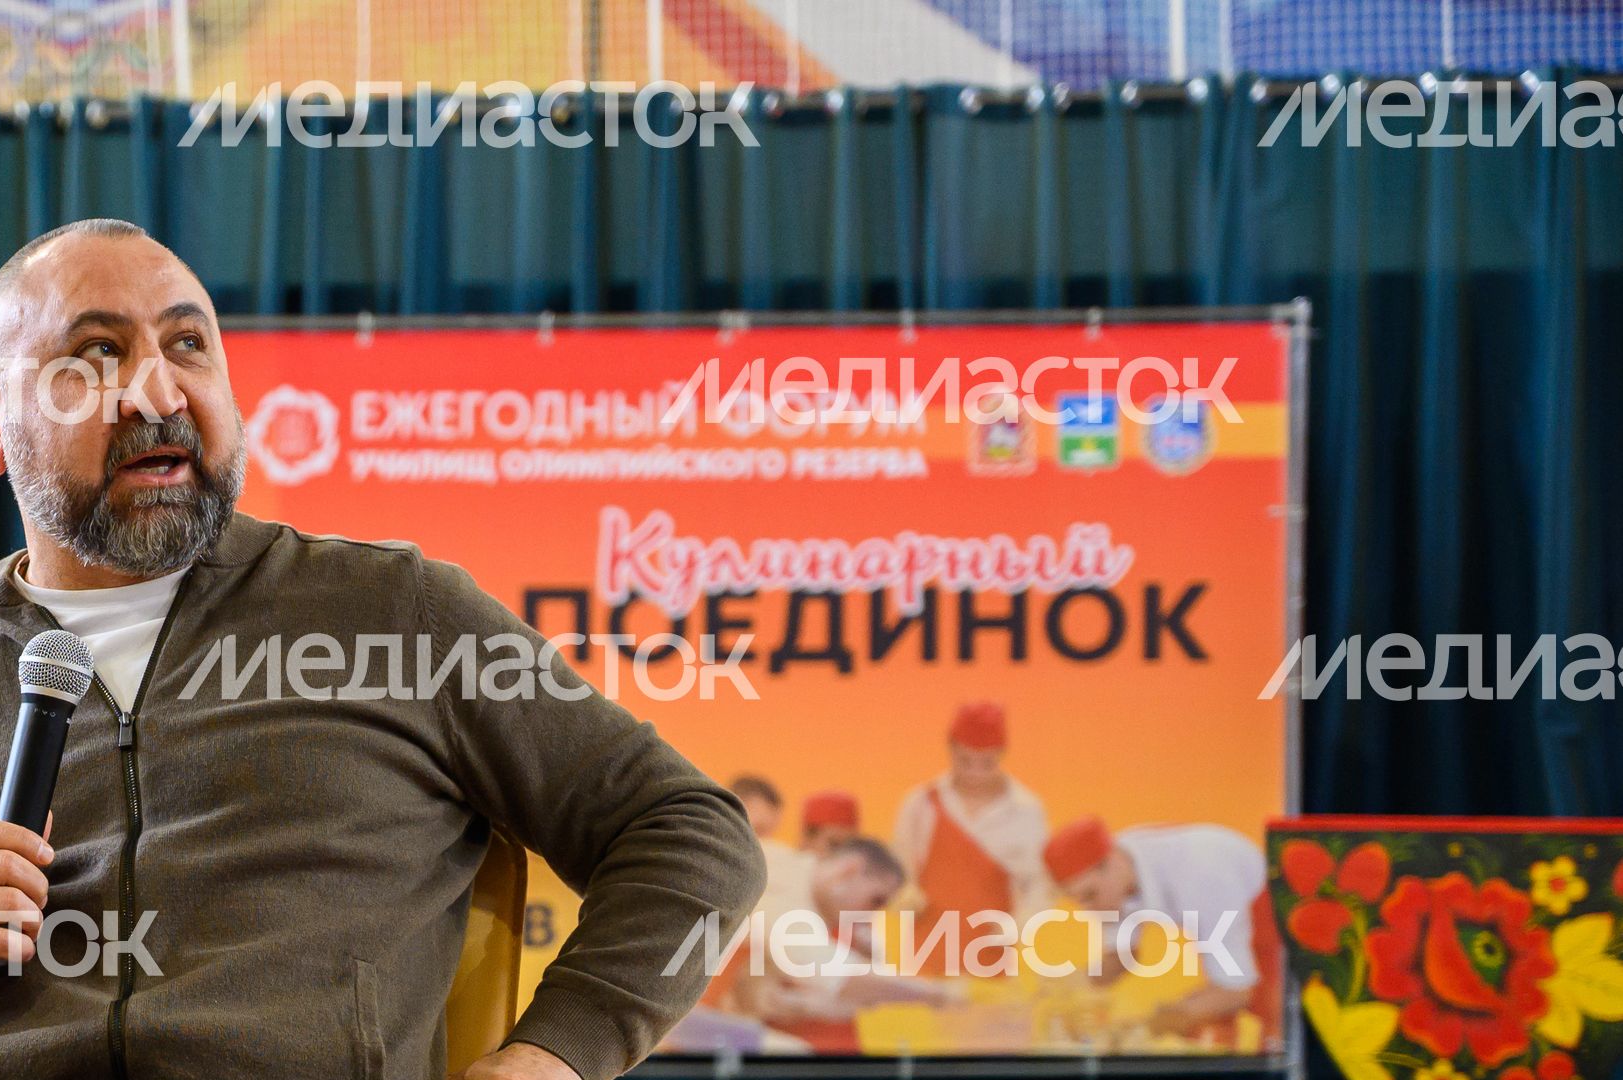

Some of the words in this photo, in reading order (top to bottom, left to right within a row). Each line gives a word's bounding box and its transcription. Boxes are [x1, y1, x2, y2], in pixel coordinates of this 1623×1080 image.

[351, 381, 698, 443] ЕЖЕГОДНЫЙ
[596, 504, 1134, 618] Кулинарный
[523, 582, 1210, 673] ПОЕДИНОК
